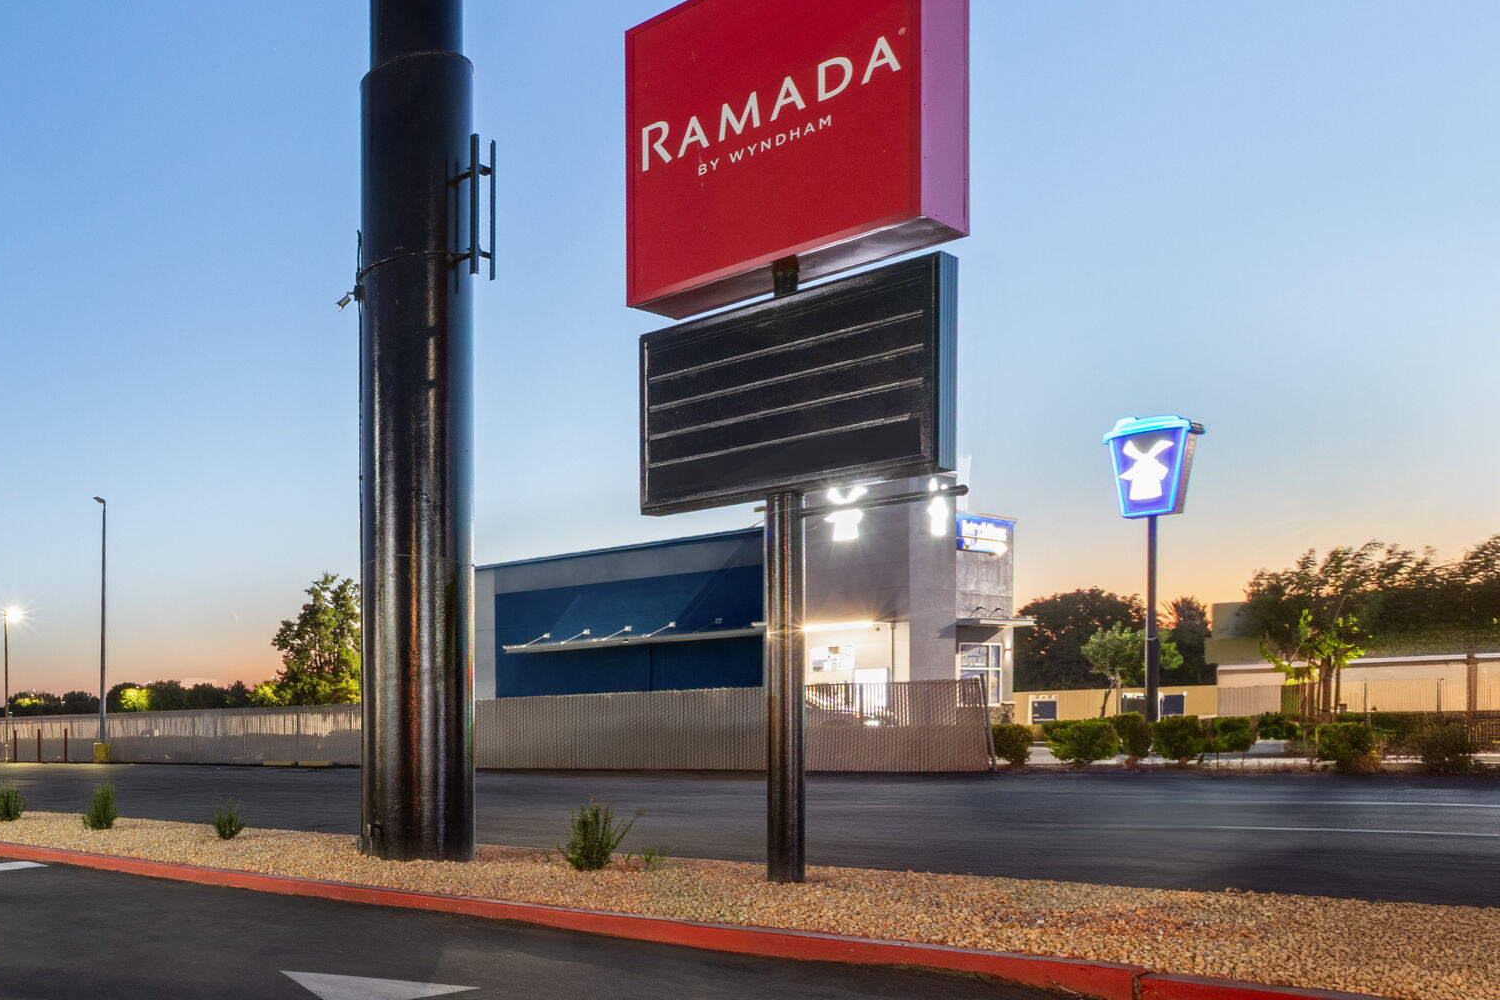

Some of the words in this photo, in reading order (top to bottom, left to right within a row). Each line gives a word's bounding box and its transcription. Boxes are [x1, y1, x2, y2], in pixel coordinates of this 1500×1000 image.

[641, 35, 902, 173] RAMADA
[698, 158, 720, 177] BY
[728, 114, 832, 164] WYNDHAM
